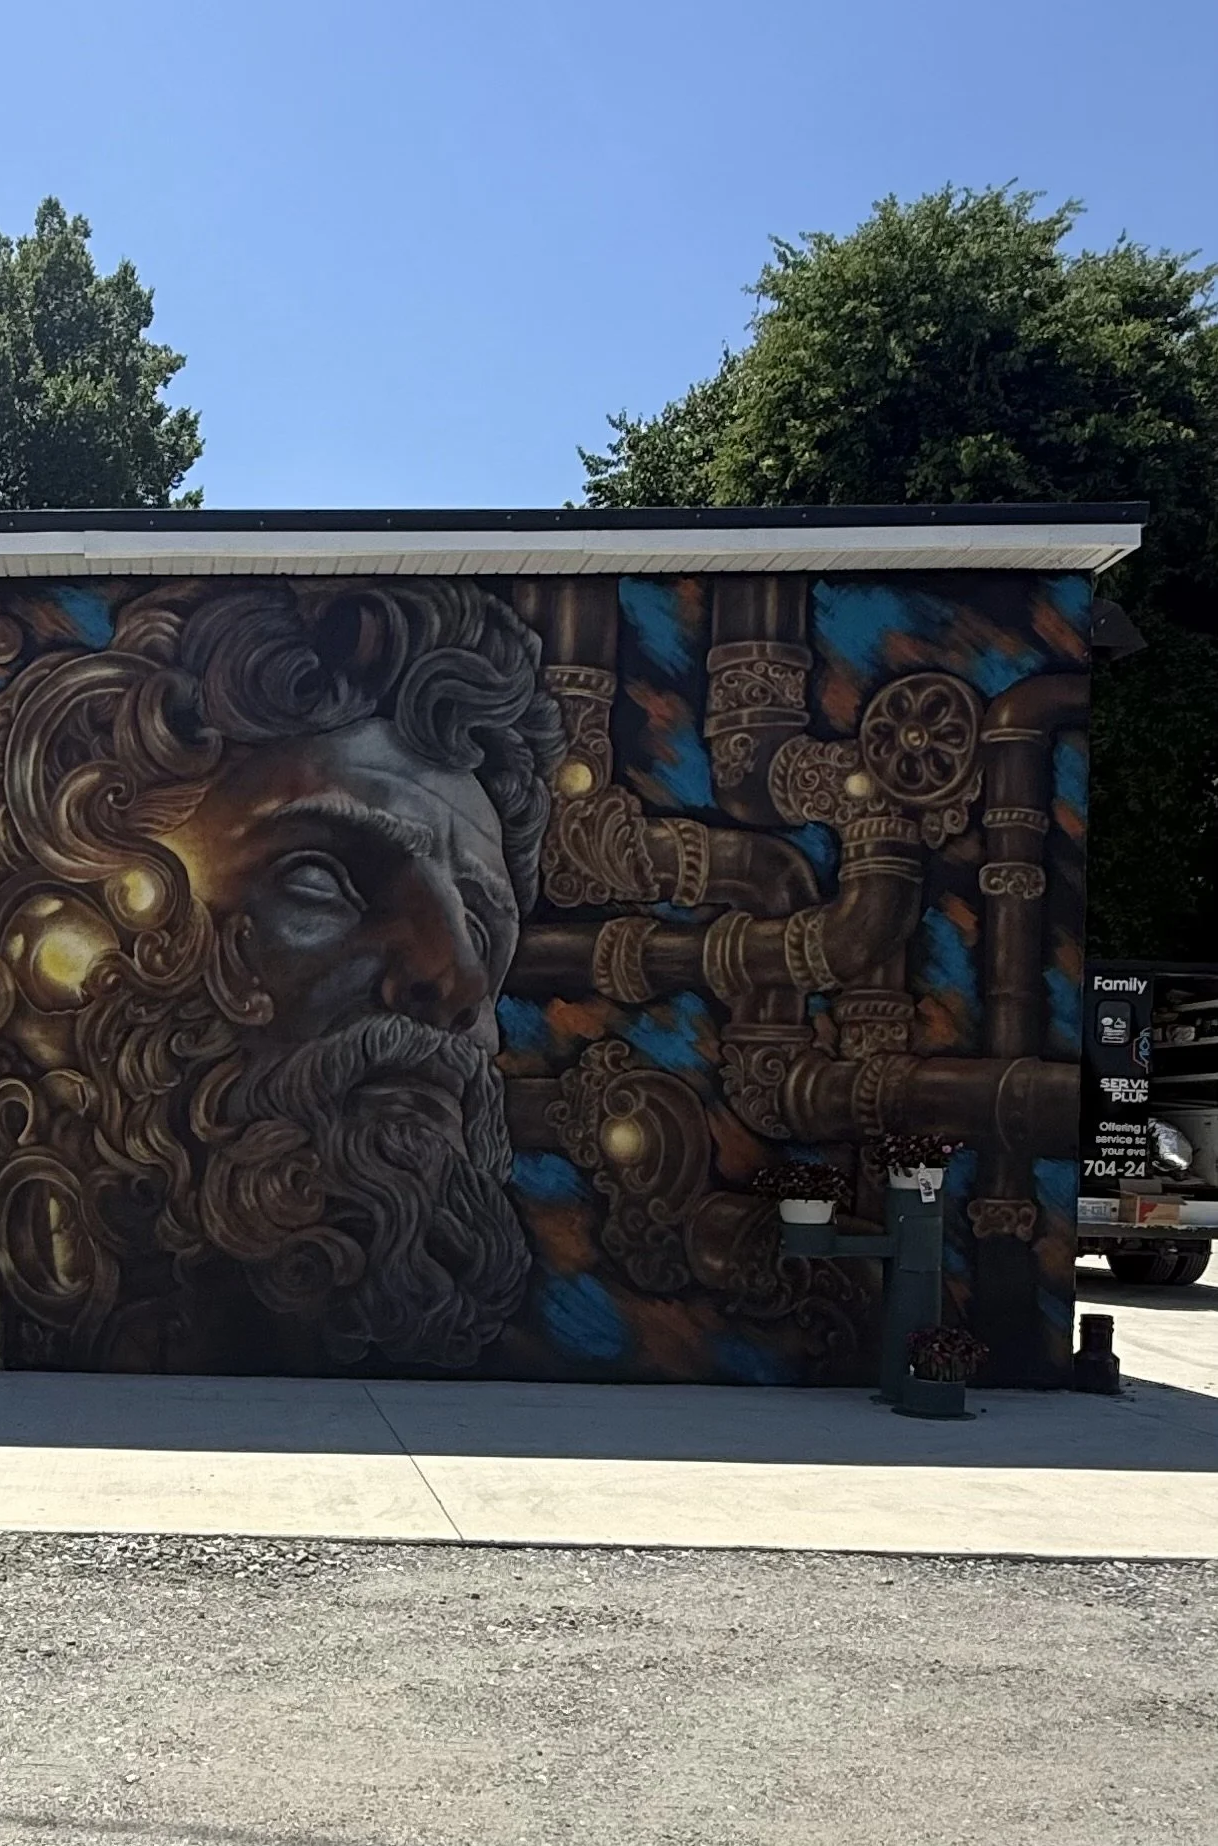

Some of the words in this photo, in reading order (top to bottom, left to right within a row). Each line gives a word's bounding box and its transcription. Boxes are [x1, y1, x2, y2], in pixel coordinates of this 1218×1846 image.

[1093, 975, 1148, 995] Family
[1098, 1121, 1141, 1134] Offering
[1095, 1135, 1133, 1145] service
[1101, 1147, 1125, 1157] your
[1083, 1159, 1146, 1177] 704-24
